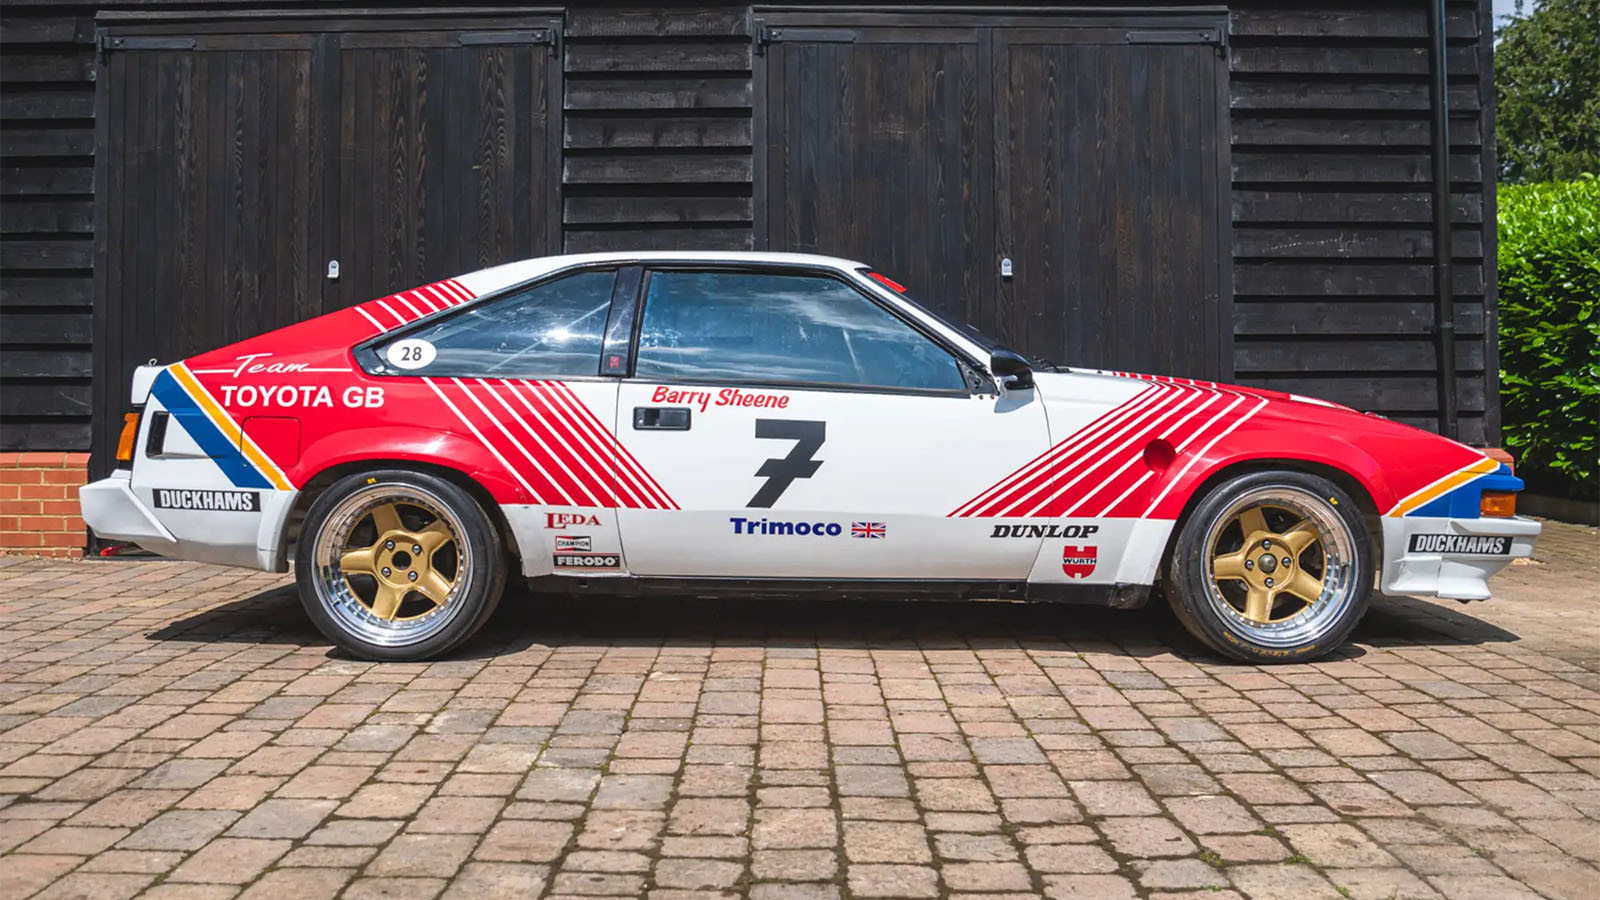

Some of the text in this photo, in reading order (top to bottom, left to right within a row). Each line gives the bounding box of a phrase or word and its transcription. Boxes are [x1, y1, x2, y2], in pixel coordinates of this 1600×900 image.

[401, 346, 423, 361] 28
[233, 352, 306, 378] Team
[220, 385, 385, 409] TOYOTA GB
[651, 386, 790, 413] Barry Sheene
[745, 418, 827, 509] 7
[160, 490, 254, 511] DUCKHAMS
[544, 512, 602, 529] LEDA
[729, 517, 842, 537] Trimoco
[990, 524, 1099, 539] DUNLOP
[1415, 534, 1505, 554] DUCKHAMS
[557, 556, 616, 566] FERODO
